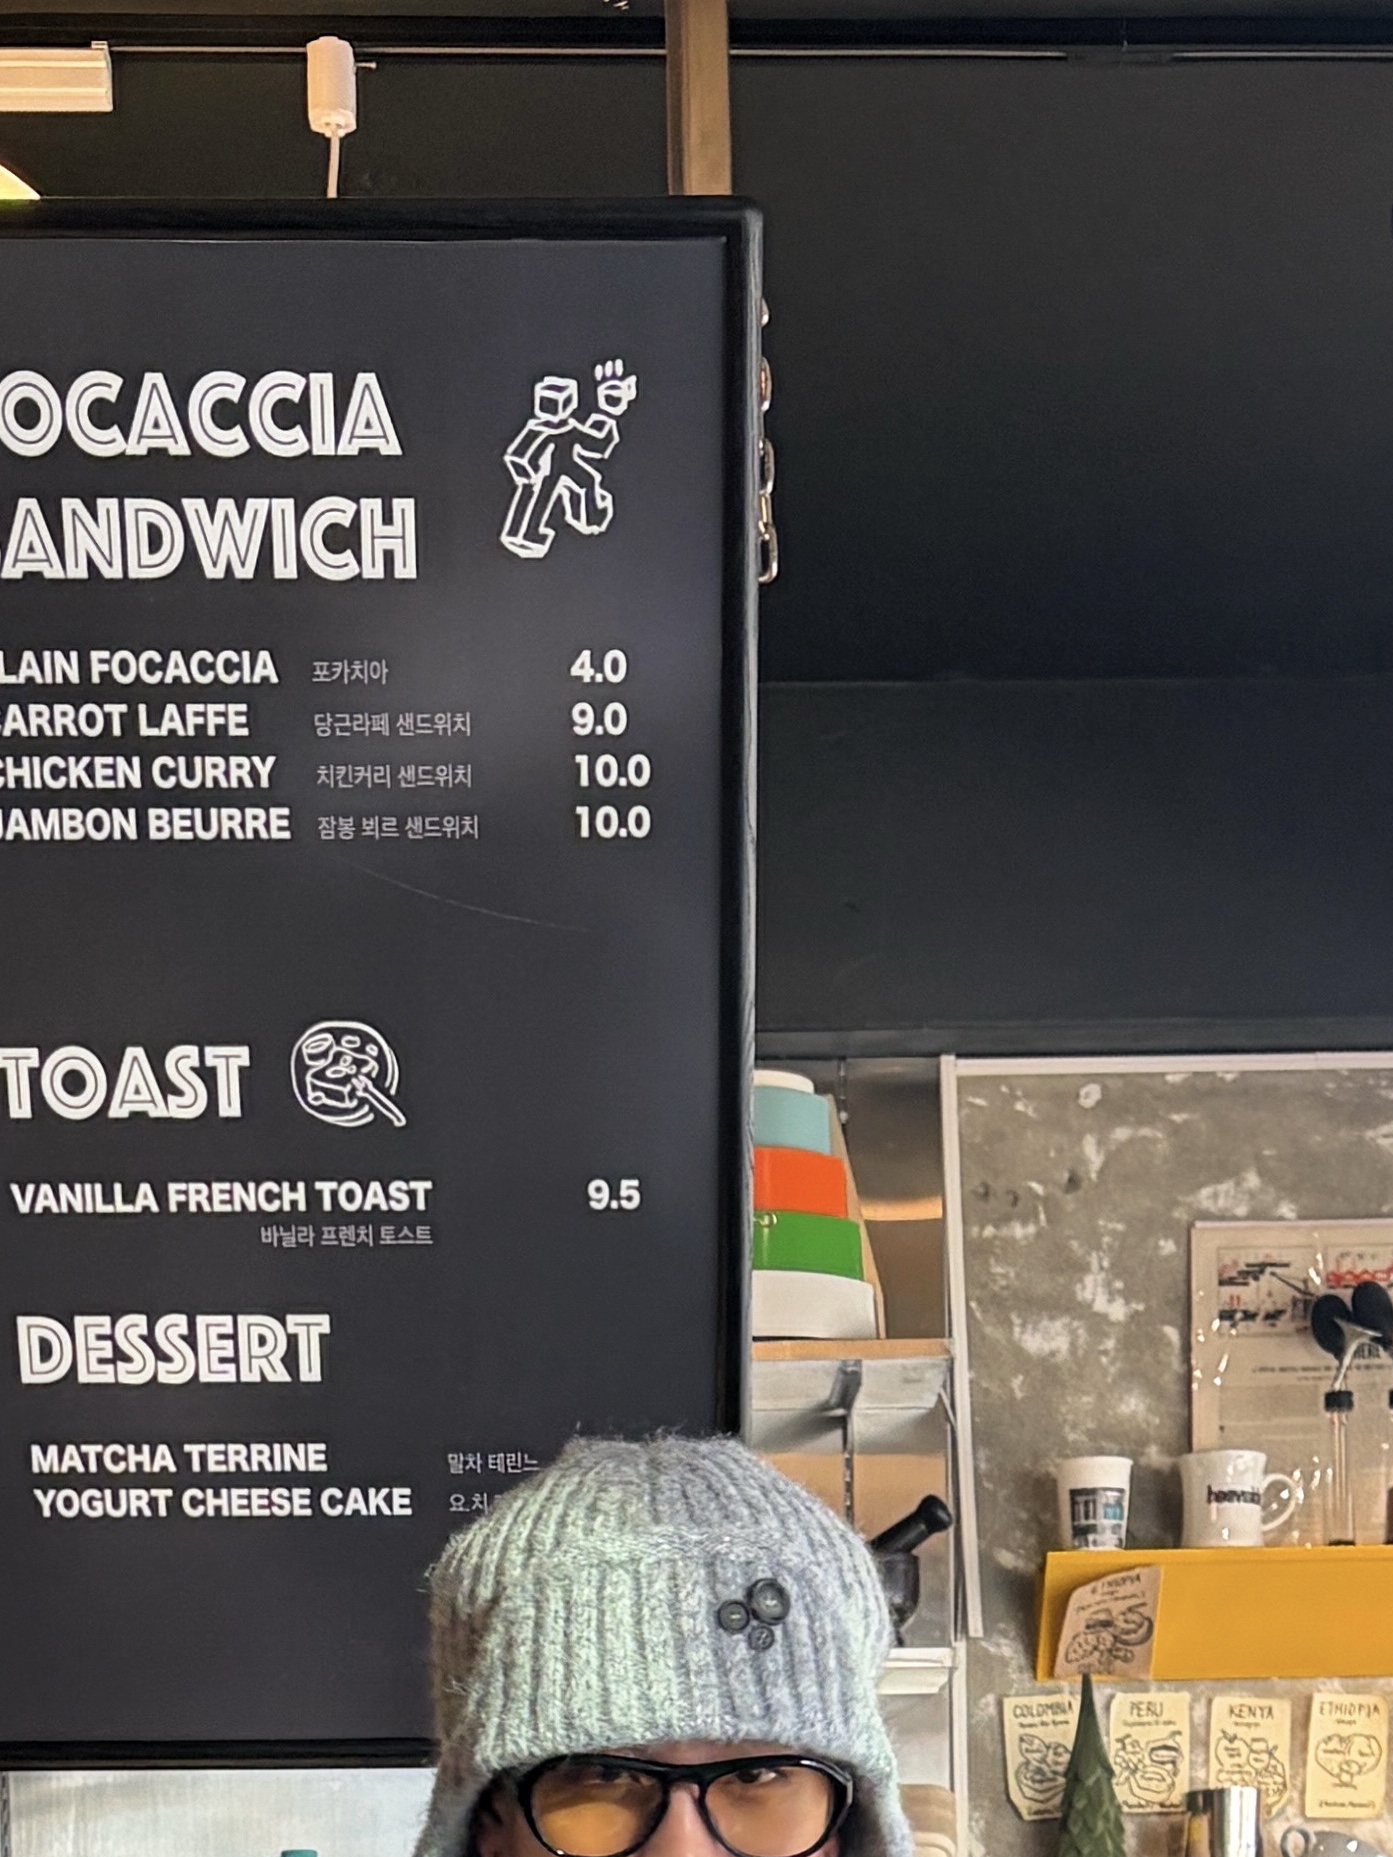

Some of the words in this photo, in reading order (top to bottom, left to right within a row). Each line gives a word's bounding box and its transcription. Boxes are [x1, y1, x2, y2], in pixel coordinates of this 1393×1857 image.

[89, 649, 279, 685] FOCACCIA
[312, 659, 389, 685] 포카치아
[570, 649, 627, 684] 4.0
[138, 703, 249, 737] LAFFE
[314, 712, 390, 737] 당근라페
[396, 711, 471, 737] 샌드위치
[571, 701, 628, 736] 9.0
[151, 755, 276, 789] CURRY
[316, 764, 391, 789] 치킨커리
[397, 763, 472, 788] 샌드위치
[574, 753, 651, 788] 10.0
[148, 807, 291, 840] BEURRE
[317, 815, 356, 840] 잠봉
[361, 815, 400, 840] 뵈르
[404, 814, 479, 840] 샌드위치
[575, 805, 651, 839] 10.0
[10, 1182, 160, 1214] VANILLA
[167, 1181, 306, 1213] FRENCH
[314, 1180, 433, 1212] TOAST
[587, 1178, 641, 1210] 9.5
[260, 1224, 315, 1248] 바닐라
[320, 1224, 374, 1248] 프렌치
[379, 1225, 434, 1245] 토스트
[17, 1314, 330, 1384] DESSERT
[31, 1443, 177, 1474] MATCHA
[183, 1443, 327, 1472] TERRINE
[447, 1452, 483, 1475] 말차
[487, 1451, 541, 1474] 테린느
[33, 1488, 174, 1518] YOGURT
[182, 1487, 312, 1517] CHEESE
[320, 1487, 413, 1517] CAKE
[1130, 1701, 1164, 1717] PERU
[1228, 1703, 1275, 1720] KENYA
[1319, 1701, 1381, 1718] ETHIOPIA
